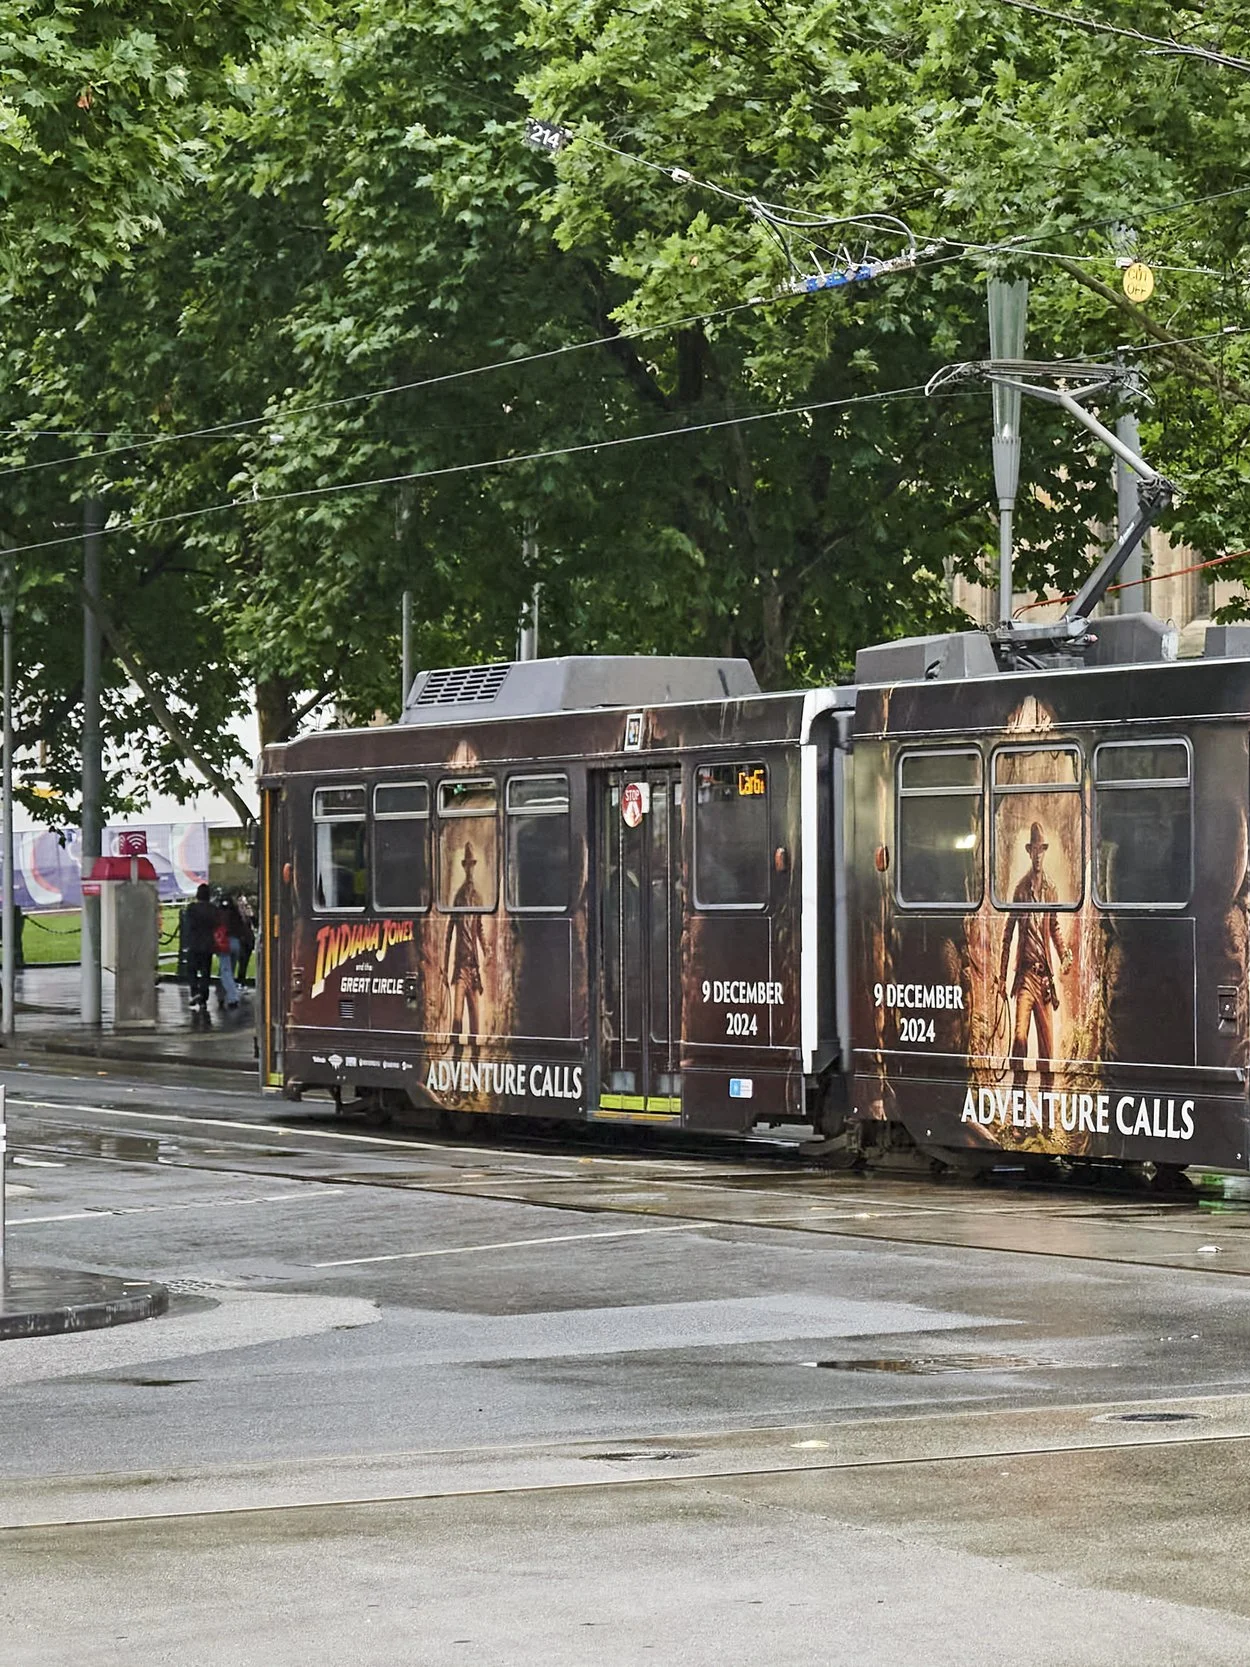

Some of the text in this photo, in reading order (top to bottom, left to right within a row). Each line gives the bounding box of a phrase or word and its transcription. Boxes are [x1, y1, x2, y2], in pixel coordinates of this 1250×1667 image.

[530, 125, 560, 148] 214
[625, 789, 640, 801] STOP
[311, 919, 414, 999] INDIANA JONES
[340, 977, 404, 995] GREAT CIRCLE
[702, 980, 785, 1005] 9 DECEMBER
[874, 983, 965, 1009] 9 DECEMBER
[726, 1012, 758, 1036] 2024
[899, 1017, 936, 1042] 2024
[426, 1060, 583, 1100] ADVENTURE CALLS
[960, 1087, 1195, 1140] ADVENTURE CALLS
